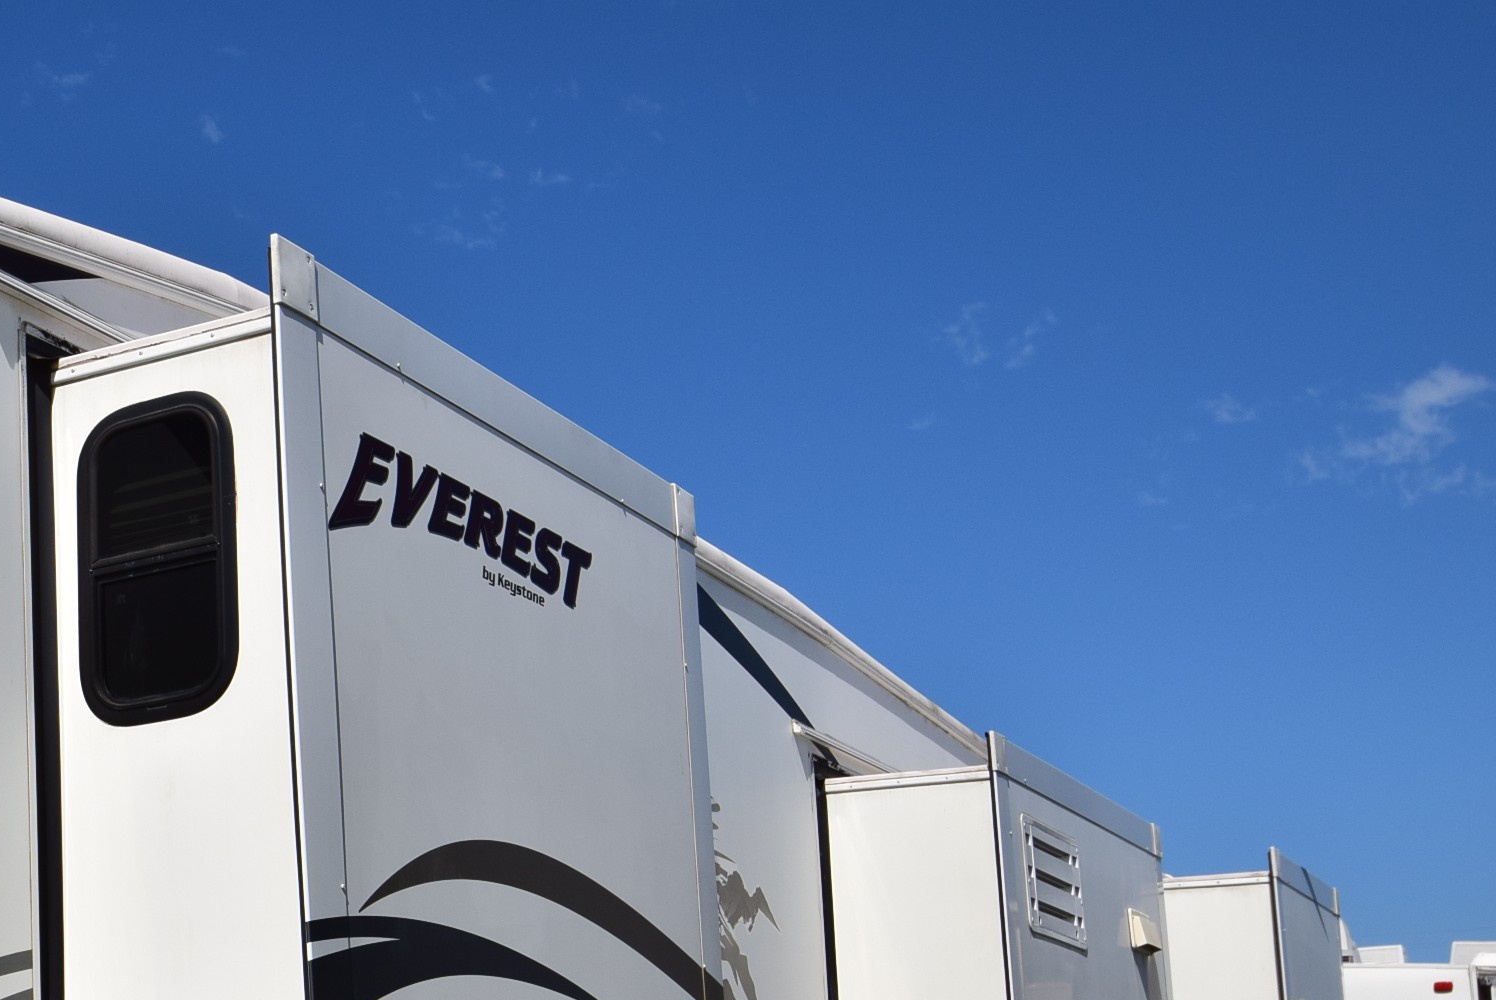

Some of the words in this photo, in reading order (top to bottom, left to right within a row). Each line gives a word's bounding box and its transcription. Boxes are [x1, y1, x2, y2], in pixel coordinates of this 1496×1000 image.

[328, 431, 592, 609] EVEREST
[482, 566, 496, 587] by
[498, 572, 546, 607] Keystone
